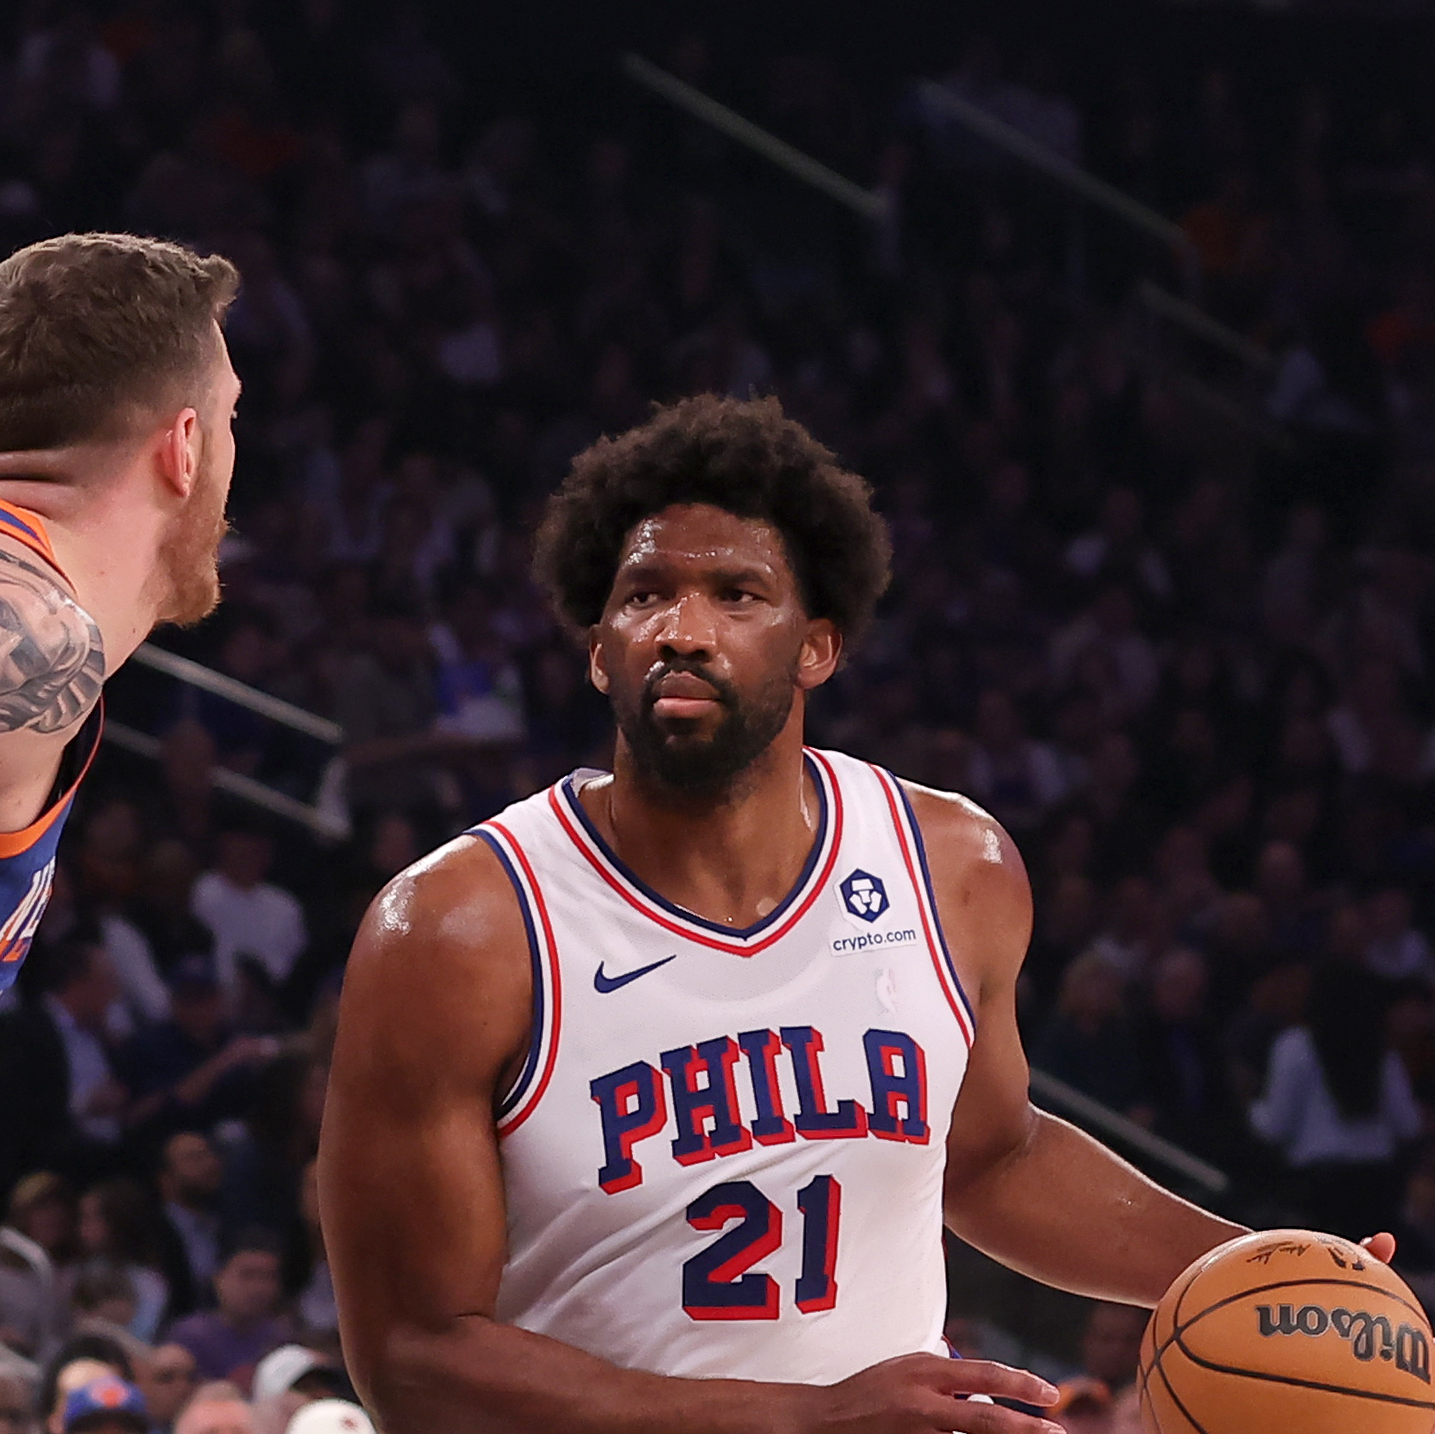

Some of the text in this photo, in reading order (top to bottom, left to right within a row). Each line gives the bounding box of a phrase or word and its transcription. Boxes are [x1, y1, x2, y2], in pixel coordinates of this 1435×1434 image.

[833, 929, 917, 951] crypto.com
[590, 1026, 930, 1195] PHILA
[683, 1174, 841, 1321] 21
[1255, 1303, 1431, 1385] Wilson
